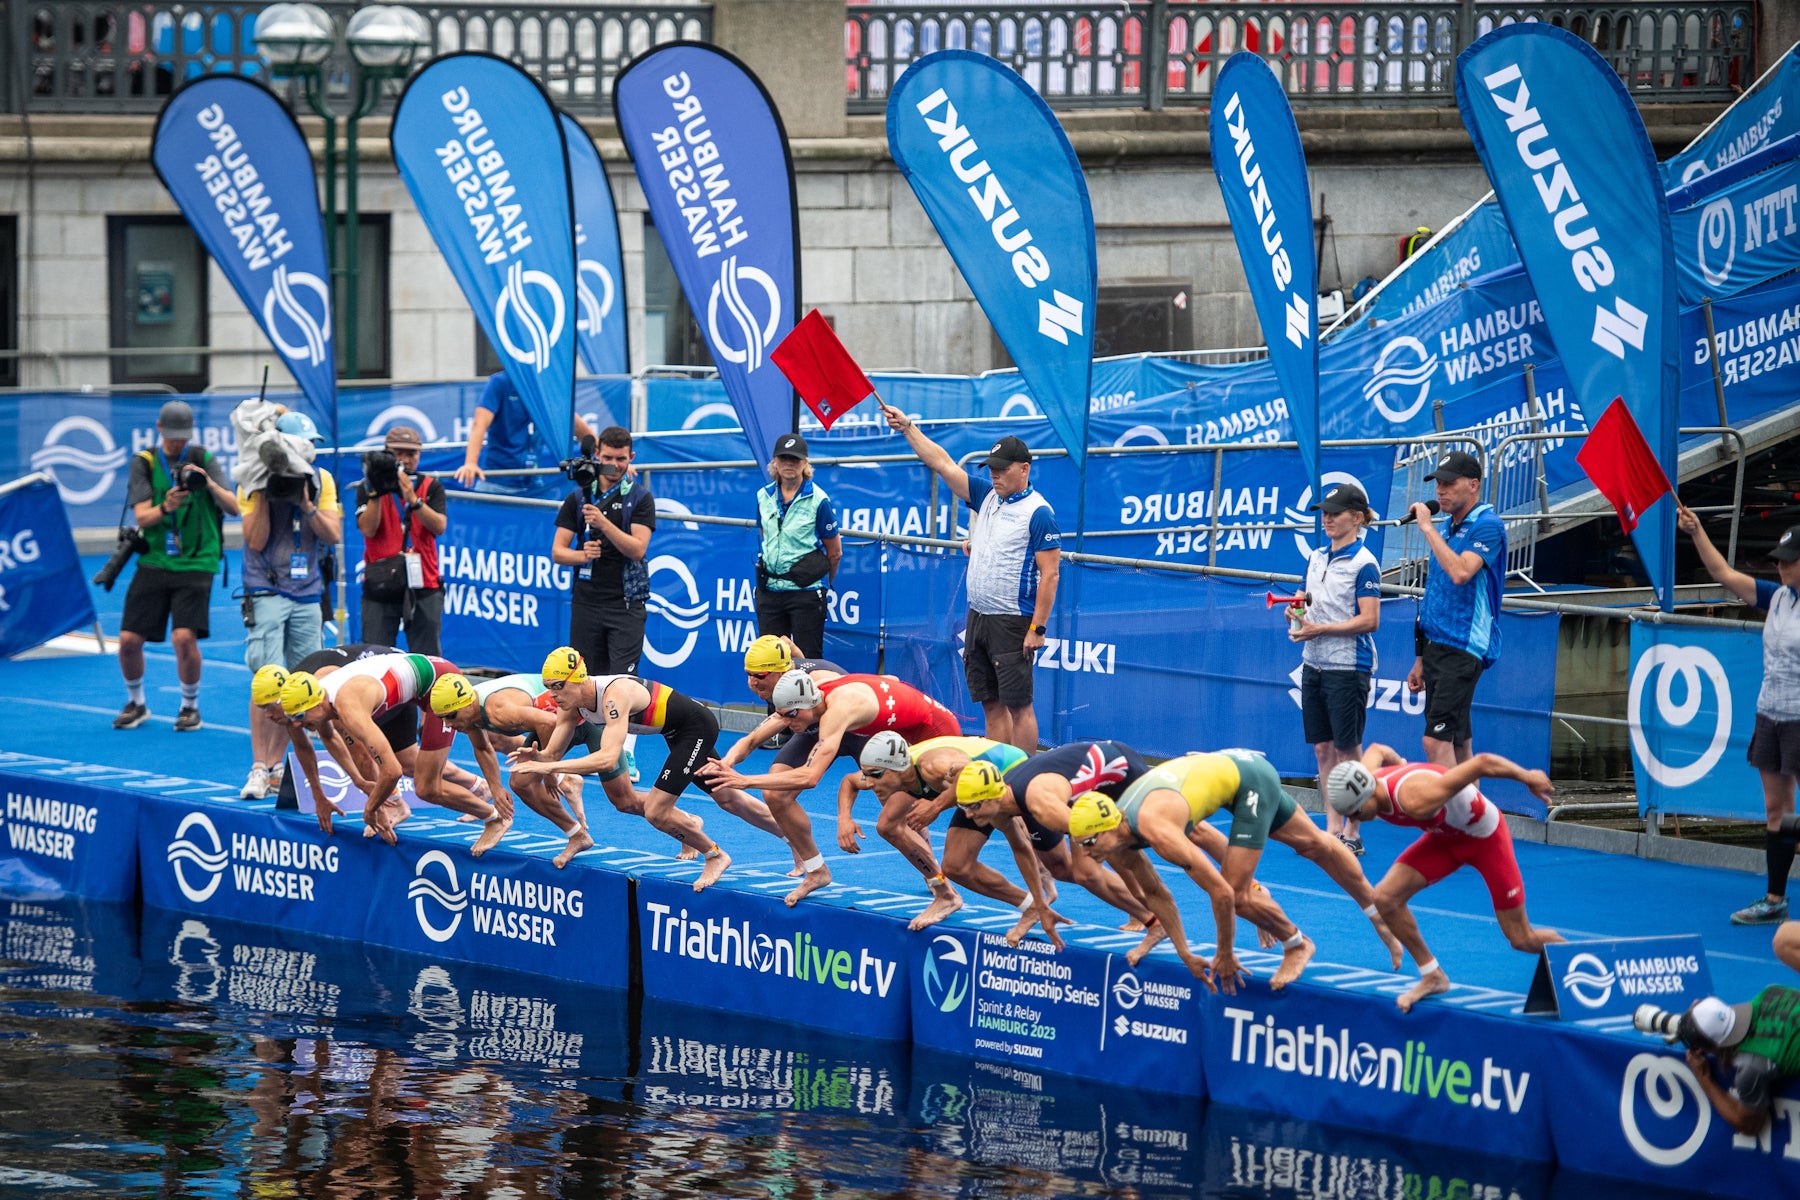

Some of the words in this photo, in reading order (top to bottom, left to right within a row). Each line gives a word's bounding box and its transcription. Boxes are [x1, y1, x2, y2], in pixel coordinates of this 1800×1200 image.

[1744, 184, 1797, 252] NTT
[1440, 300, 1544, 357] HAMBUR
[1444, 332, 1535, 386] WASSER
[1186, 397, 1290, 445] HAMBUR
[439, 544, 571, 590] HAMBURG
[444, 583, 539, 629] WASSER
[567, 653, 577, 670] 9
[775, 642, 785, 660] 1
[1033, 638, 1116, 675] ZUKI
[273, 671, 286, 688] 3
[301, 679, 313, 697] 7
[453, 680, 468, 698] 2
[885, 738, 908, 759] 14
[979, 767, 1003, 787] 10
[1345, 768, 1369, 796] 19
[7, 792, 98, 835] HAMBURG
[1097, 799, 1110, 819] 5
[8, 822, 76, 861] WASSER
[231, 832, 339, 873] HAMBURG
[232, 864, 315, 902] WASSER
[470, 872, 584, 918] HAMBURG
[471, 904, 557, 947] WASSER
[982, 949, 1017, 971] World
[1018, 958, 1072, 981] Triathlon
[1615, 954, 1699, 977] HAMBURG
[979, 970, 1063, 1004] Championship
[1064, 985, 1100, 1008] Series
[1143, 981, 1191, 1000] HAMBURG
[1619, 975, 1685, 997] WASSER
[978, 998, 1003, 1017] Sprint
[1005, 1003, 1012, 1017] &
[1013, 1006, 1041, 1024] Relay
[1143, 994, 1180, 1011] WASSER
[977, 1014, 1028, 1037] HAMBURG
[1030, 1023, 1056, 1041] 2023
[1131, 1021, 1188, 1045] SUZUKI
[975, 1038, 1004, 1053] powered
[1004, 1041, 1013, 1055] by
[1013, 1043, 1042, 1058] SUZUKI
